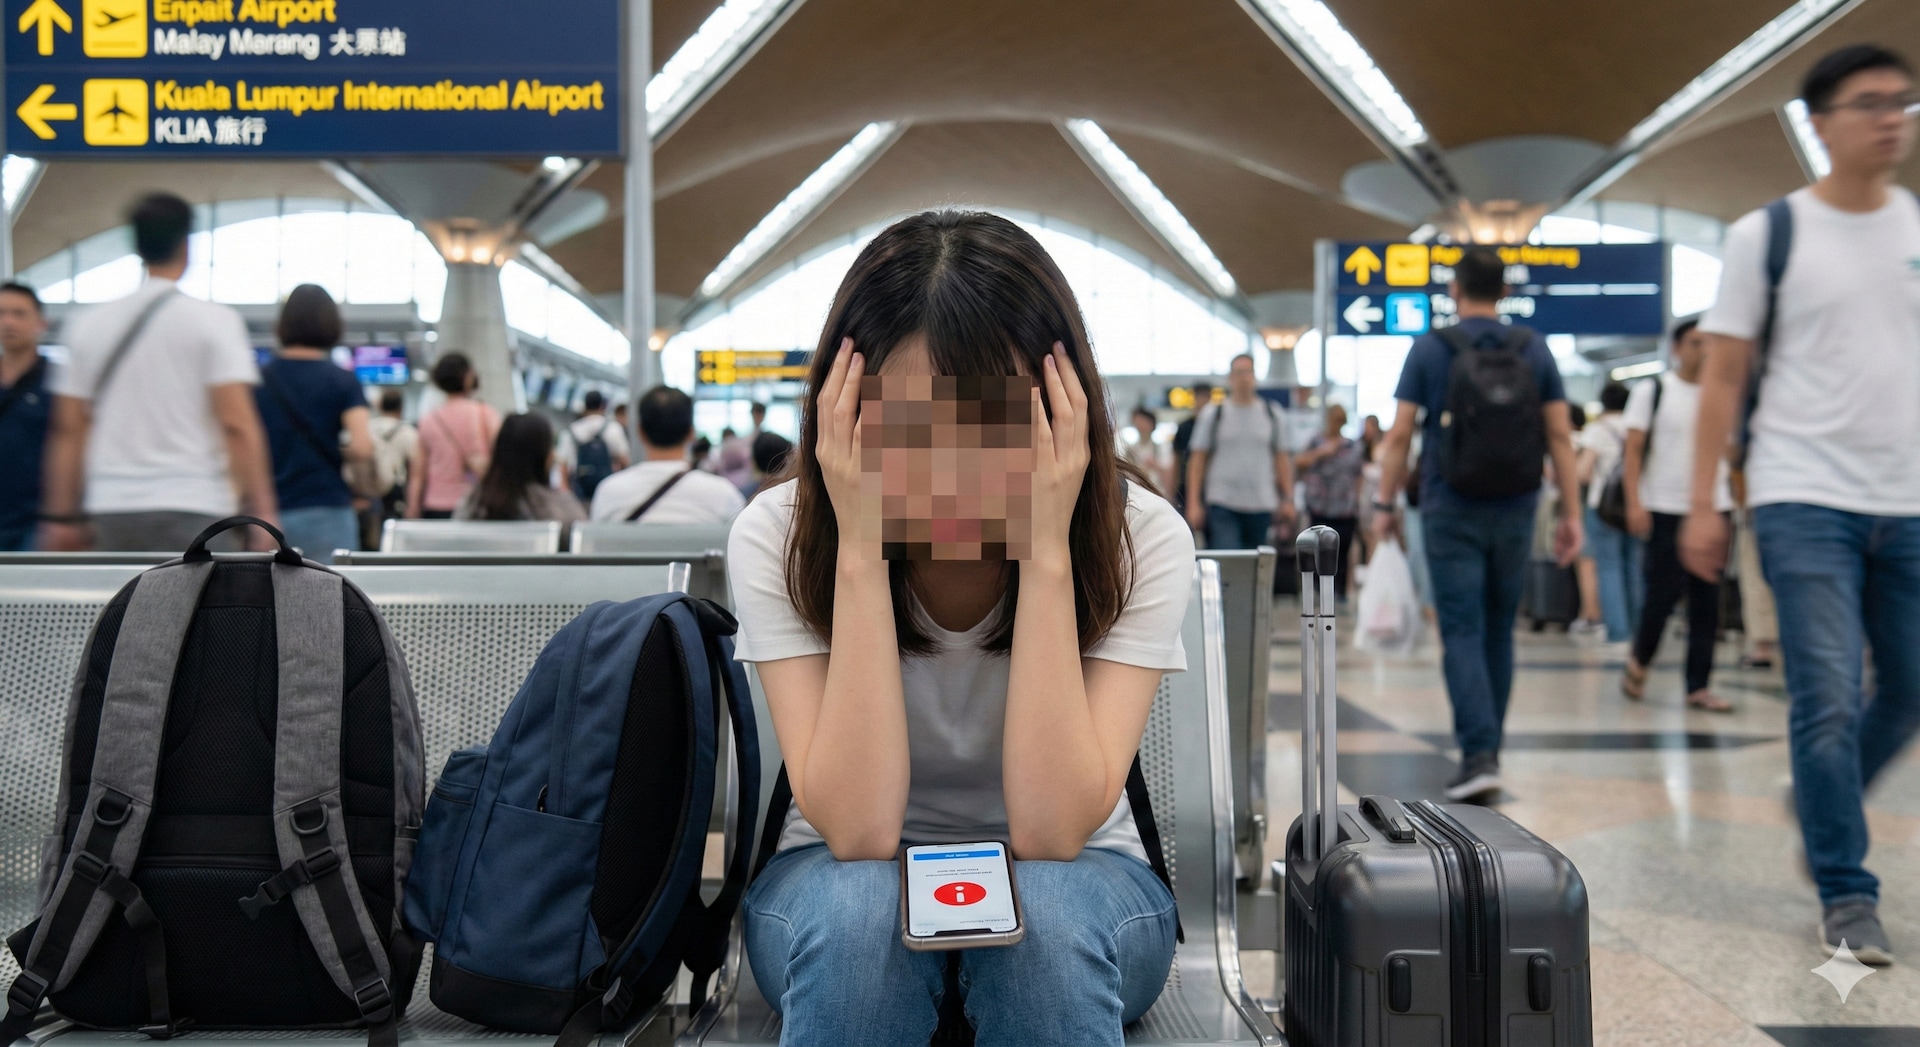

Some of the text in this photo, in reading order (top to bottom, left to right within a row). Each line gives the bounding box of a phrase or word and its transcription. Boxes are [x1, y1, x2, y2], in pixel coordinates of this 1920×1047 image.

[238, 0, 337, 29] Airport
[154, 27, 226, 60] Malay
[154, 79, 604, 117] Kuala Lumpur International Airport
[154, 117, 213, 144] KLIA
